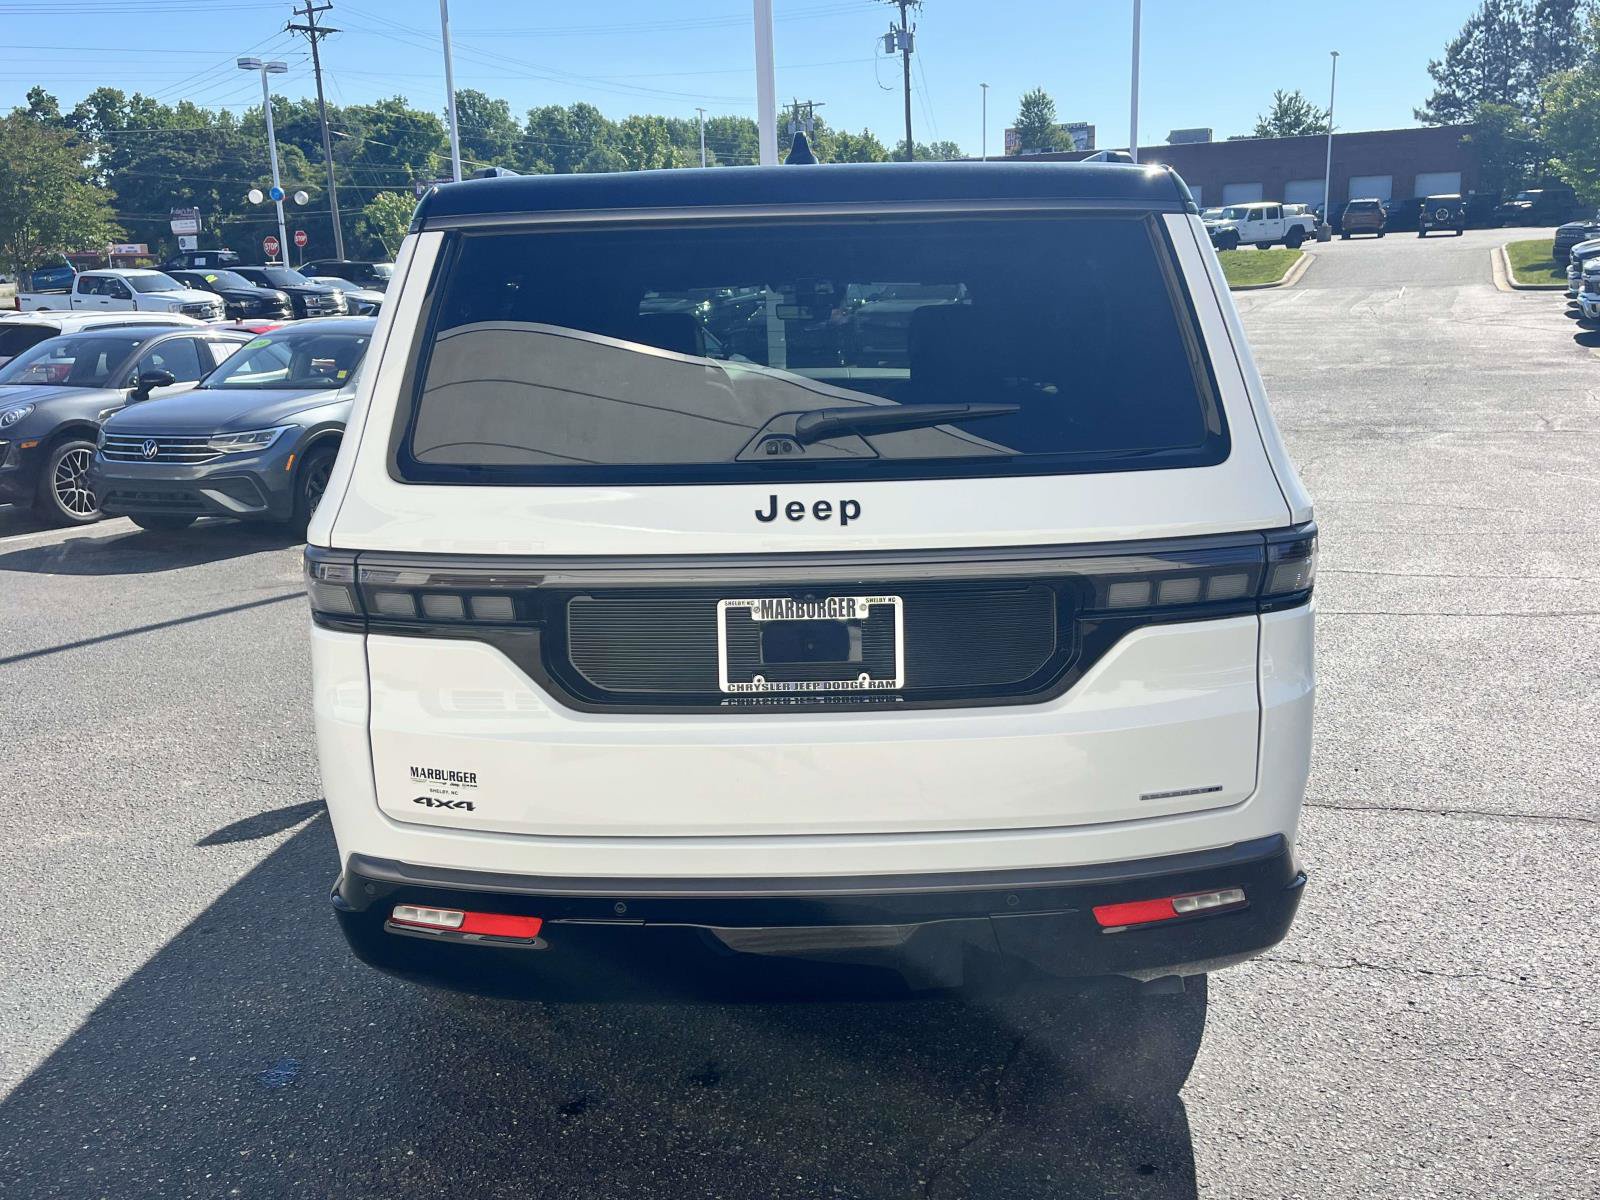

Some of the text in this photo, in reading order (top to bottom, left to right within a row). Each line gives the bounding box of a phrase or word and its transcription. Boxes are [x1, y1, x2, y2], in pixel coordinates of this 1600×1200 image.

[264, 242, 278, 251] STOP
[755, 494, 861, 526] Jeep
[865, 596, 886, 604] SHELBY
[761, 597, 857, 620] MARBURGER
[727, 680, 897, 692] CHRYSLER JEEP DODGE RAM
[410, 766, 477, 784] MARBURGER
